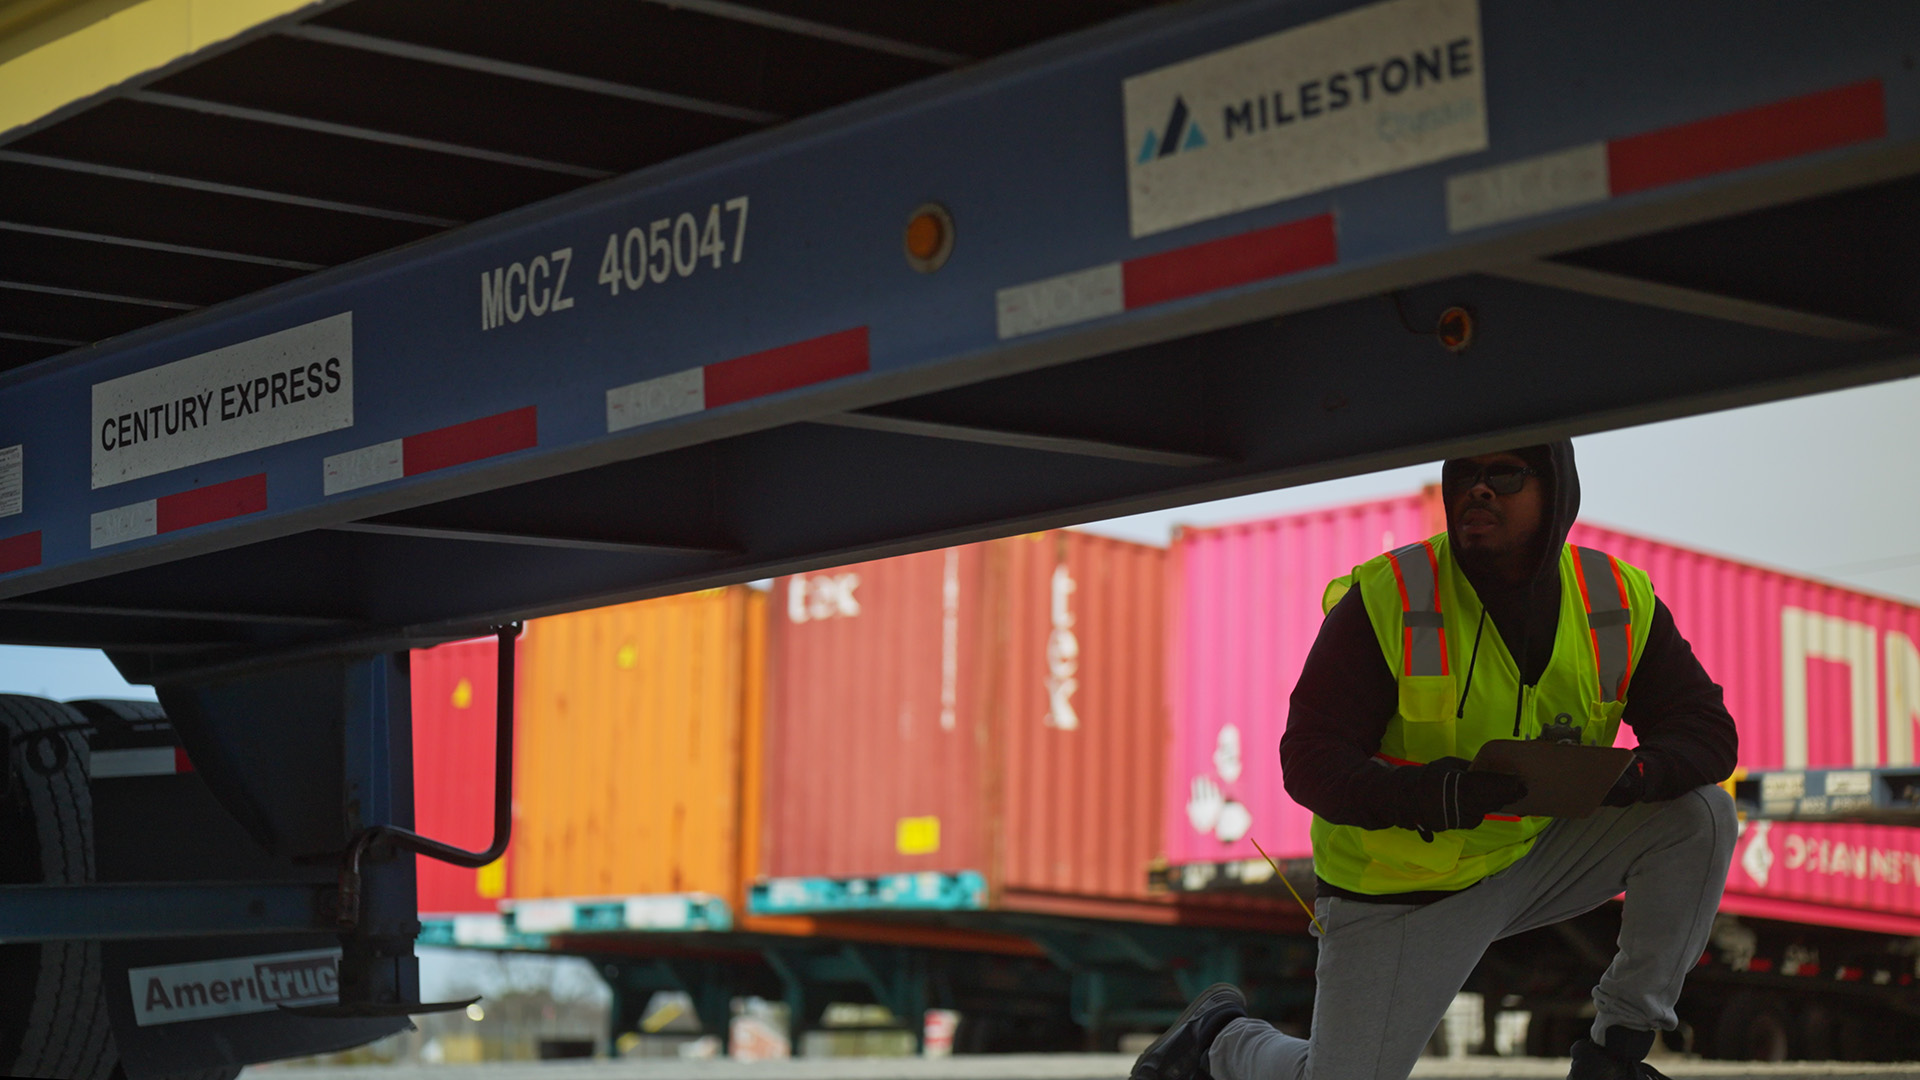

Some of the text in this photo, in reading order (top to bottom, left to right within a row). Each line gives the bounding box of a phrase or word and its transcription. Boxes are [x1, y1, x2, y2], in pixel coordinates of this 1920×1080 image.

[1223, 36, 1474, 142] MILESTONE
[481, 195, 750, 332] MCCZ 405047
[101, 356, 341, 452] CENTURY EXPRESS
